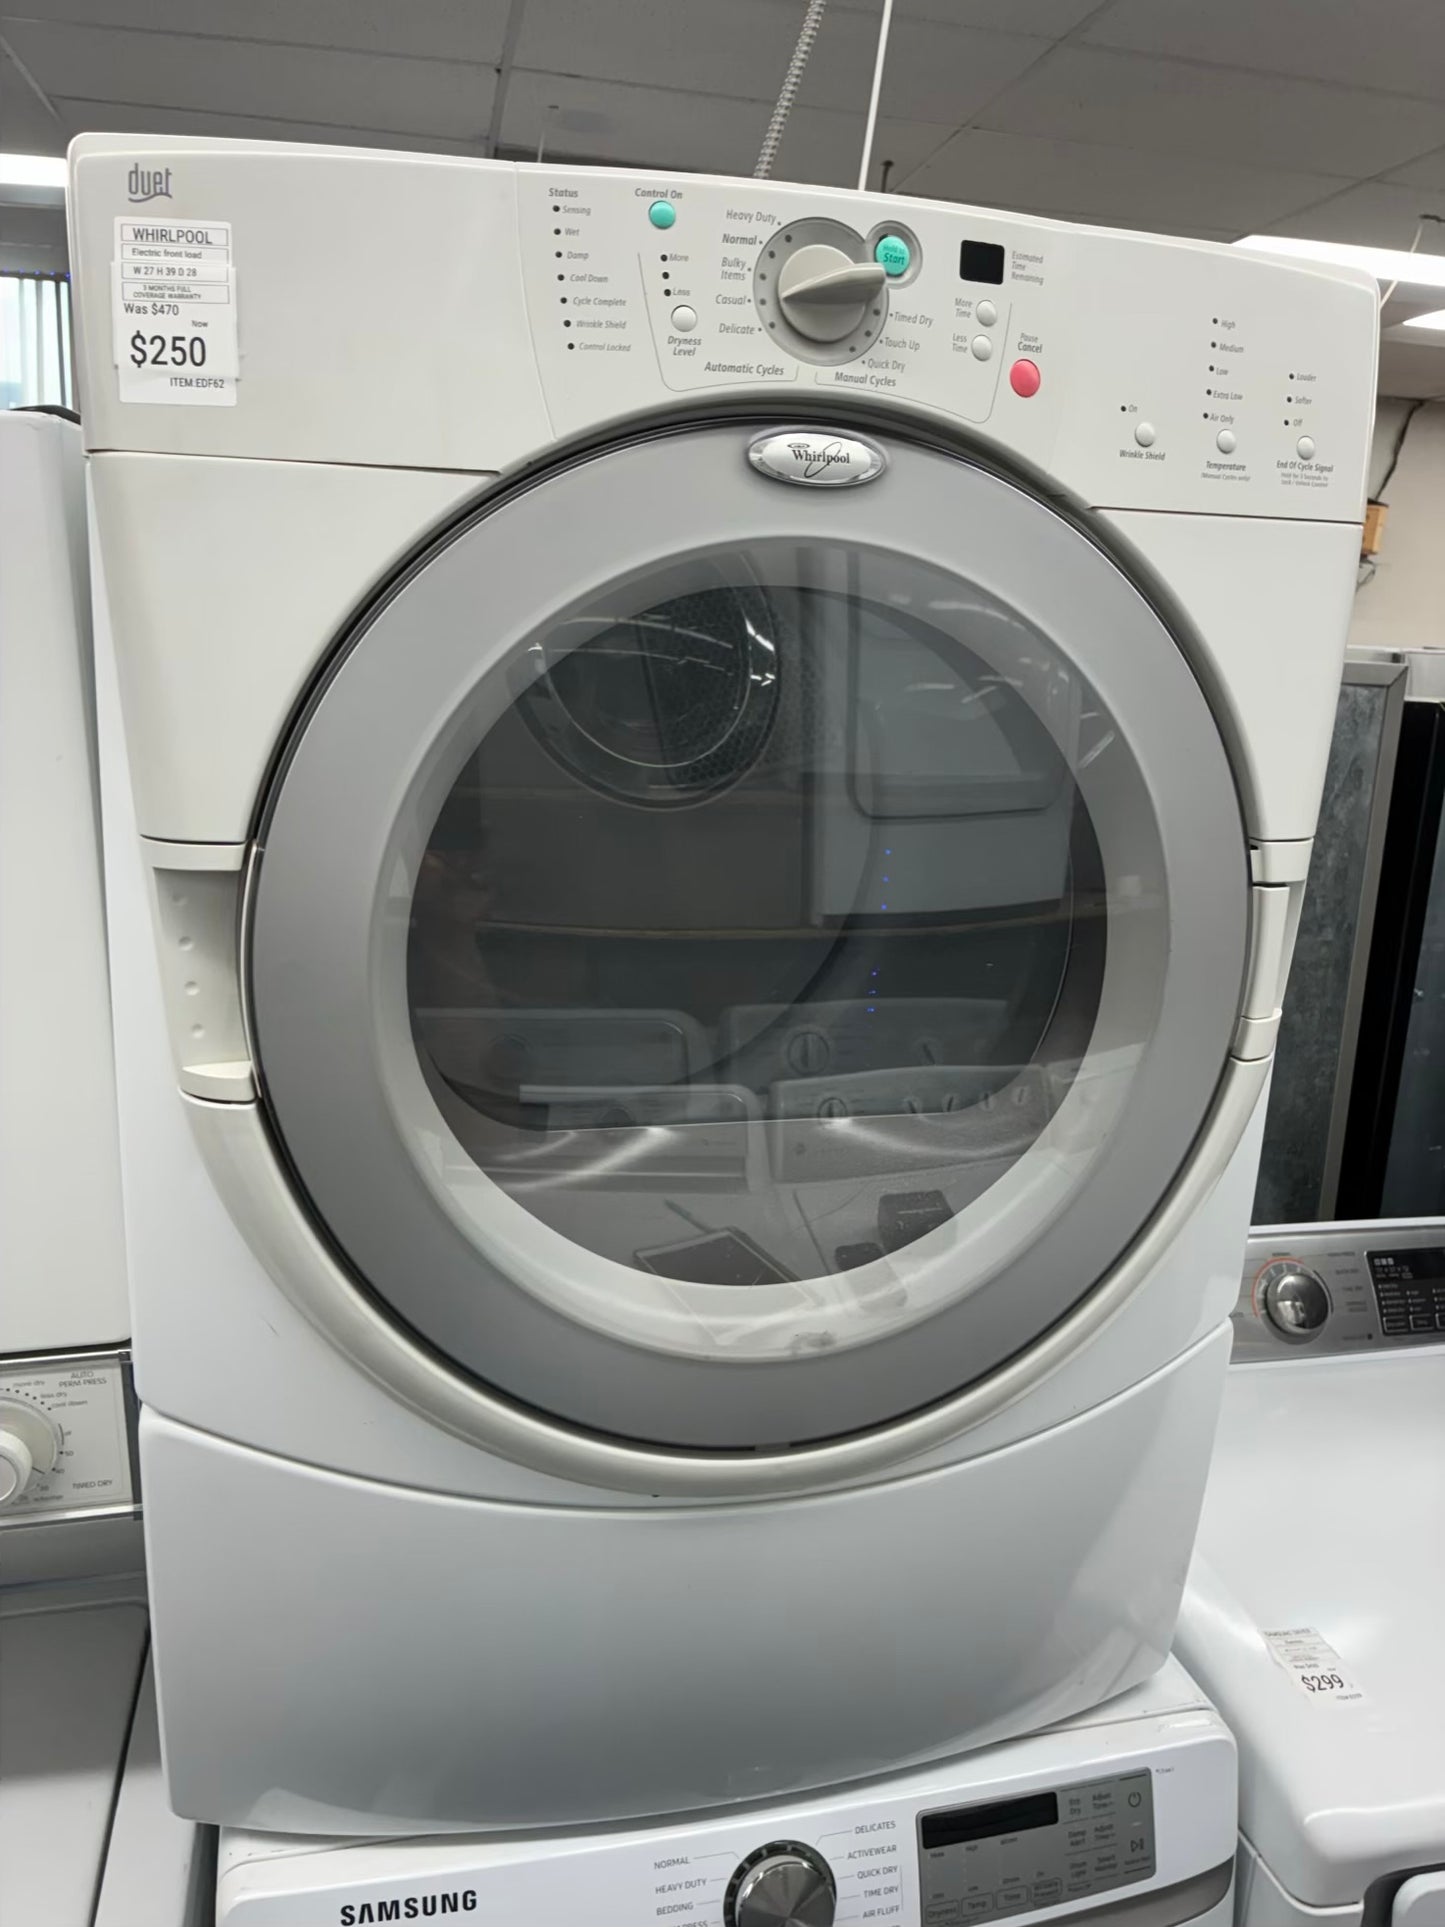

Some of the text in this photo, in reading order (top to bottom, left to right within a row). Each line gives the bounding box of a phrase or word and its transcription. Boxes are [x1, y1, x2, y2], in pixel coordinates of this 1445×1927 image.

[127, 163, 173, 200] duet
[549, 187, 578, 198] Status
[635, 187, 683, 200] Control On
[562, 205, 591, 216] Sensing
[726, 209, 776, 225] Heavy Duty
[132, 227, 213, 245] WHIRLPOOL
[565, 228, 580, 236] Wet
[722, 233, 757, 245] Normal
[132, 248, 202, 259] Electric front load
[567, 251, 589, 260] Damp
[670, 254, 689, 262] More
[883, 252, 905, 265] Start
[1012, 250, 1043, 264] Estimated
[721, 257, 746, 271] Bulky
[1012, 261, 1026, 271] Time
[133, 266, 197, 277] W 27 H 39 D 28
[721, 271, 746, 280] Items
[570, 273, 587, 282] Cool
[1012, 271, 1044, 285] Remaining
[673, 288, 690, 297] Less
[573, 296, 626, 307] Cycle Complete
[715, 294, 746, 305] Casual
[954, 298, 973, 308] More
[124, 302, 180, 316] Was $470
[956, 308, 972, 319] Time
[191, 320, 208, 328] Now
[576, 320, 626, 330] Wrinkle Shield
[894, 312, 934, 328] Timed Dry
[1221, 320, 1236, 330] High
[719, 323, 755, 335] Delicate
[667, 336, 702, 346] Dryness
[952, 333, 968, 343] Less
[1020, 333, 1038, 343] Pause
[130, 330, 206, 368] $250
[579, 342, 631, 352] Control Locked
[885, 337, 920, 351] Touch Up
[952, 343, 968, 353] Time
[1017, 341, 1043, 353] Cancel
[1219, 343, 1244, 353] Medium
[673, 346, 696, 357] Level
[704, 361, 784, 377] Automatic Cycles
[868, 358, 906, 374] Quick Dry
[1216, 368, 1228, 376] Low
[170, 377, 225, 389] ITEM:EDF62
[834, 372, 896, 387] Manual Cycles
[1213, 390, 1243, 401] Extra Low
[1129, 404, 1138, 413] On
[1210, 413, 1234, 425] Air Only
[1293, 418, 1303, 427] Off
[791, 449, 850, 467] Whirlpool
[1119, 450, 1165, 462] Wrinkle Shield
[1206, 461, 1246, 472] Temperature
[1277, 460, 1334, 474] End Of Cycle Signal
[70, 1371, 94, 1380] AUTO
[58, 1378, 107, 1388] PERM PRESS
[72, 1479, 113, 1489] TIMED DRY
[1301, 1674, 1344, 1693] $299
[855, 1821, 896, 1834] DELICATES
[848, 1845, 897, 1860] ACTIVEWEAR
[654, 1857, 690, 1869] NORMAL
[857, 1865, 898, 1879] QUICK DRY
[655, 1878, 707, 1894] HEAVY DUTY
[864, 1886, 899, 1898] TIME DRY
[340, 1890, 477, 1926] SAMSUNG
[656, 1902, 694, 1916] BEDDING
[863, 1905, 900, 1919] AIR FLUFF
